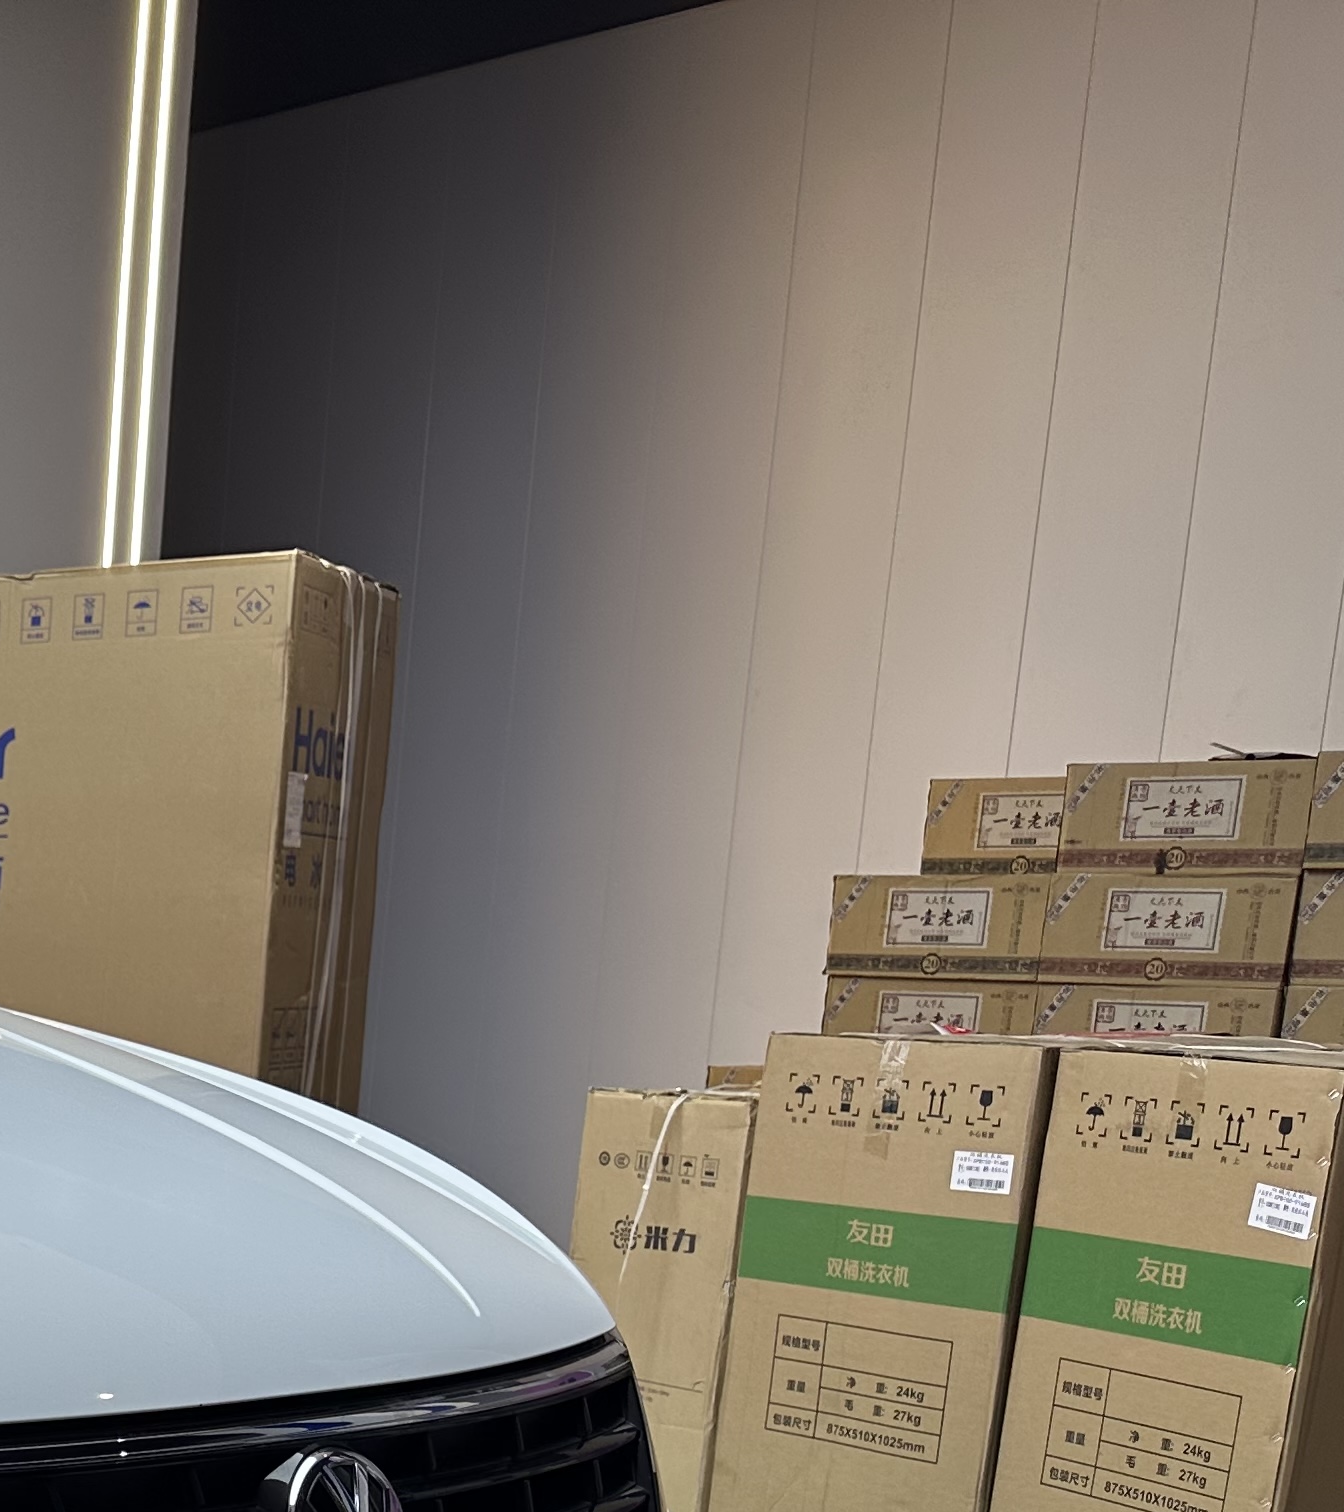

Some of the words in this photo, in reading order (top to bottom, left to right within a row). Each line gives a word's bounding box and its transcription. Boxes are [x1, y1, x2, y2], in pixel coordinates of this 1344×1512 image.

[1012, 861, 1027, 872] 20
[1167, 851, 1183, 864] 20
[924, 958, 938, 971] 20
[1148, 963, 1162, 975] 20
[644, 1225, 697, 1253] 米力
[846, 1219, 894, 1247] 友田
[825, 1257, 909, 1288] 双桶洗衣机
[1135, 1256, 1187, 1289] 友田
[1112, 1297, 1202, 1334] 双桶洗衣机
[781, 1334, 821, 1352] 规格型号
[896, 1385, 925, 1403] 24kg
[1061, 1380, 1103, 1401] 规格型号
[773, 1412, 812, 1431] 包装尺寸
[893, 1409, 922, 1428] 27kg
[826, 1423, 925, 1454] 875X510X1025mm
[1182, 1442, 1212, 1463] 24kg
[1049, 1466, 1090, 1488] 包装尺寸
[1178, 1468, 1207, 1489] 27kg
